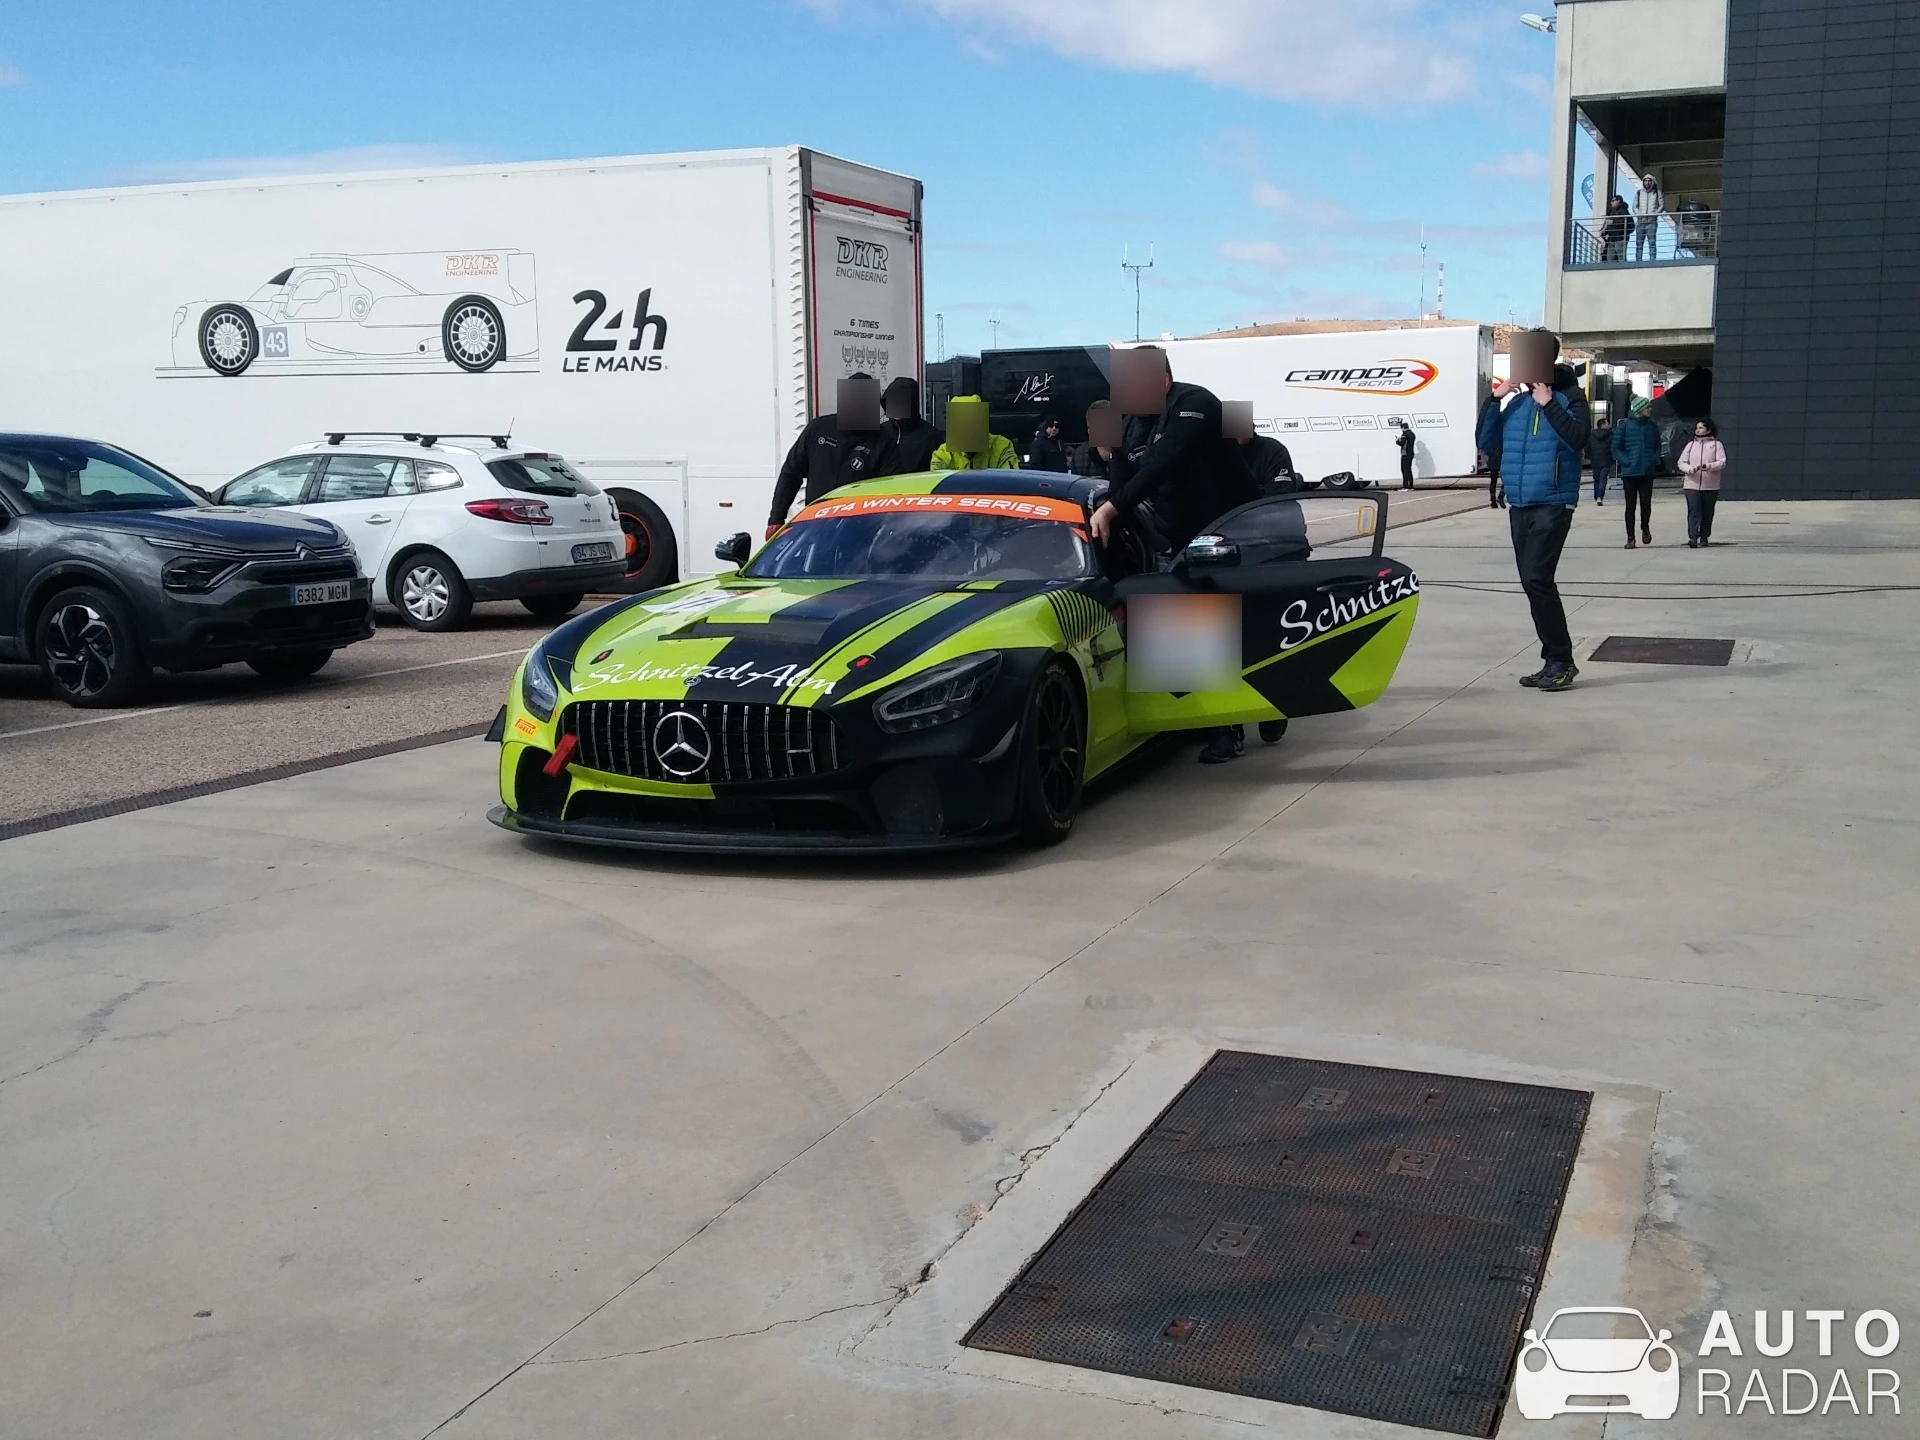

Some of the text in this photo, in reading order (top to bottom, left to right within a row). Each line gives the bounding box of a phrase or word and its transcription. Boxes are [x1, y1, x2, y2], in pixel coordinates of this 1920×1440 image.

[445, 254, 499, 270] DKR
[836, 236, 889, 271] DKR
[836, 267, 888, 284] ENGINEERING
[565, 287, 667, 352] 24h
[850, 318, 880, 329] 6 TIMES
[266, 331, 286, 352] 43
[833, 329, 895, 341] CHAMPIONSHIP WINNER
[562, 355, 662, 372] LE MANS
[1285, 366, 1407, 384] campos
[1347, 379, 1403, 388] racing
[815, 497, 1053, 519] GT4 WINTER SERIES
[297, 584, 348, 603] 6382 MGM
